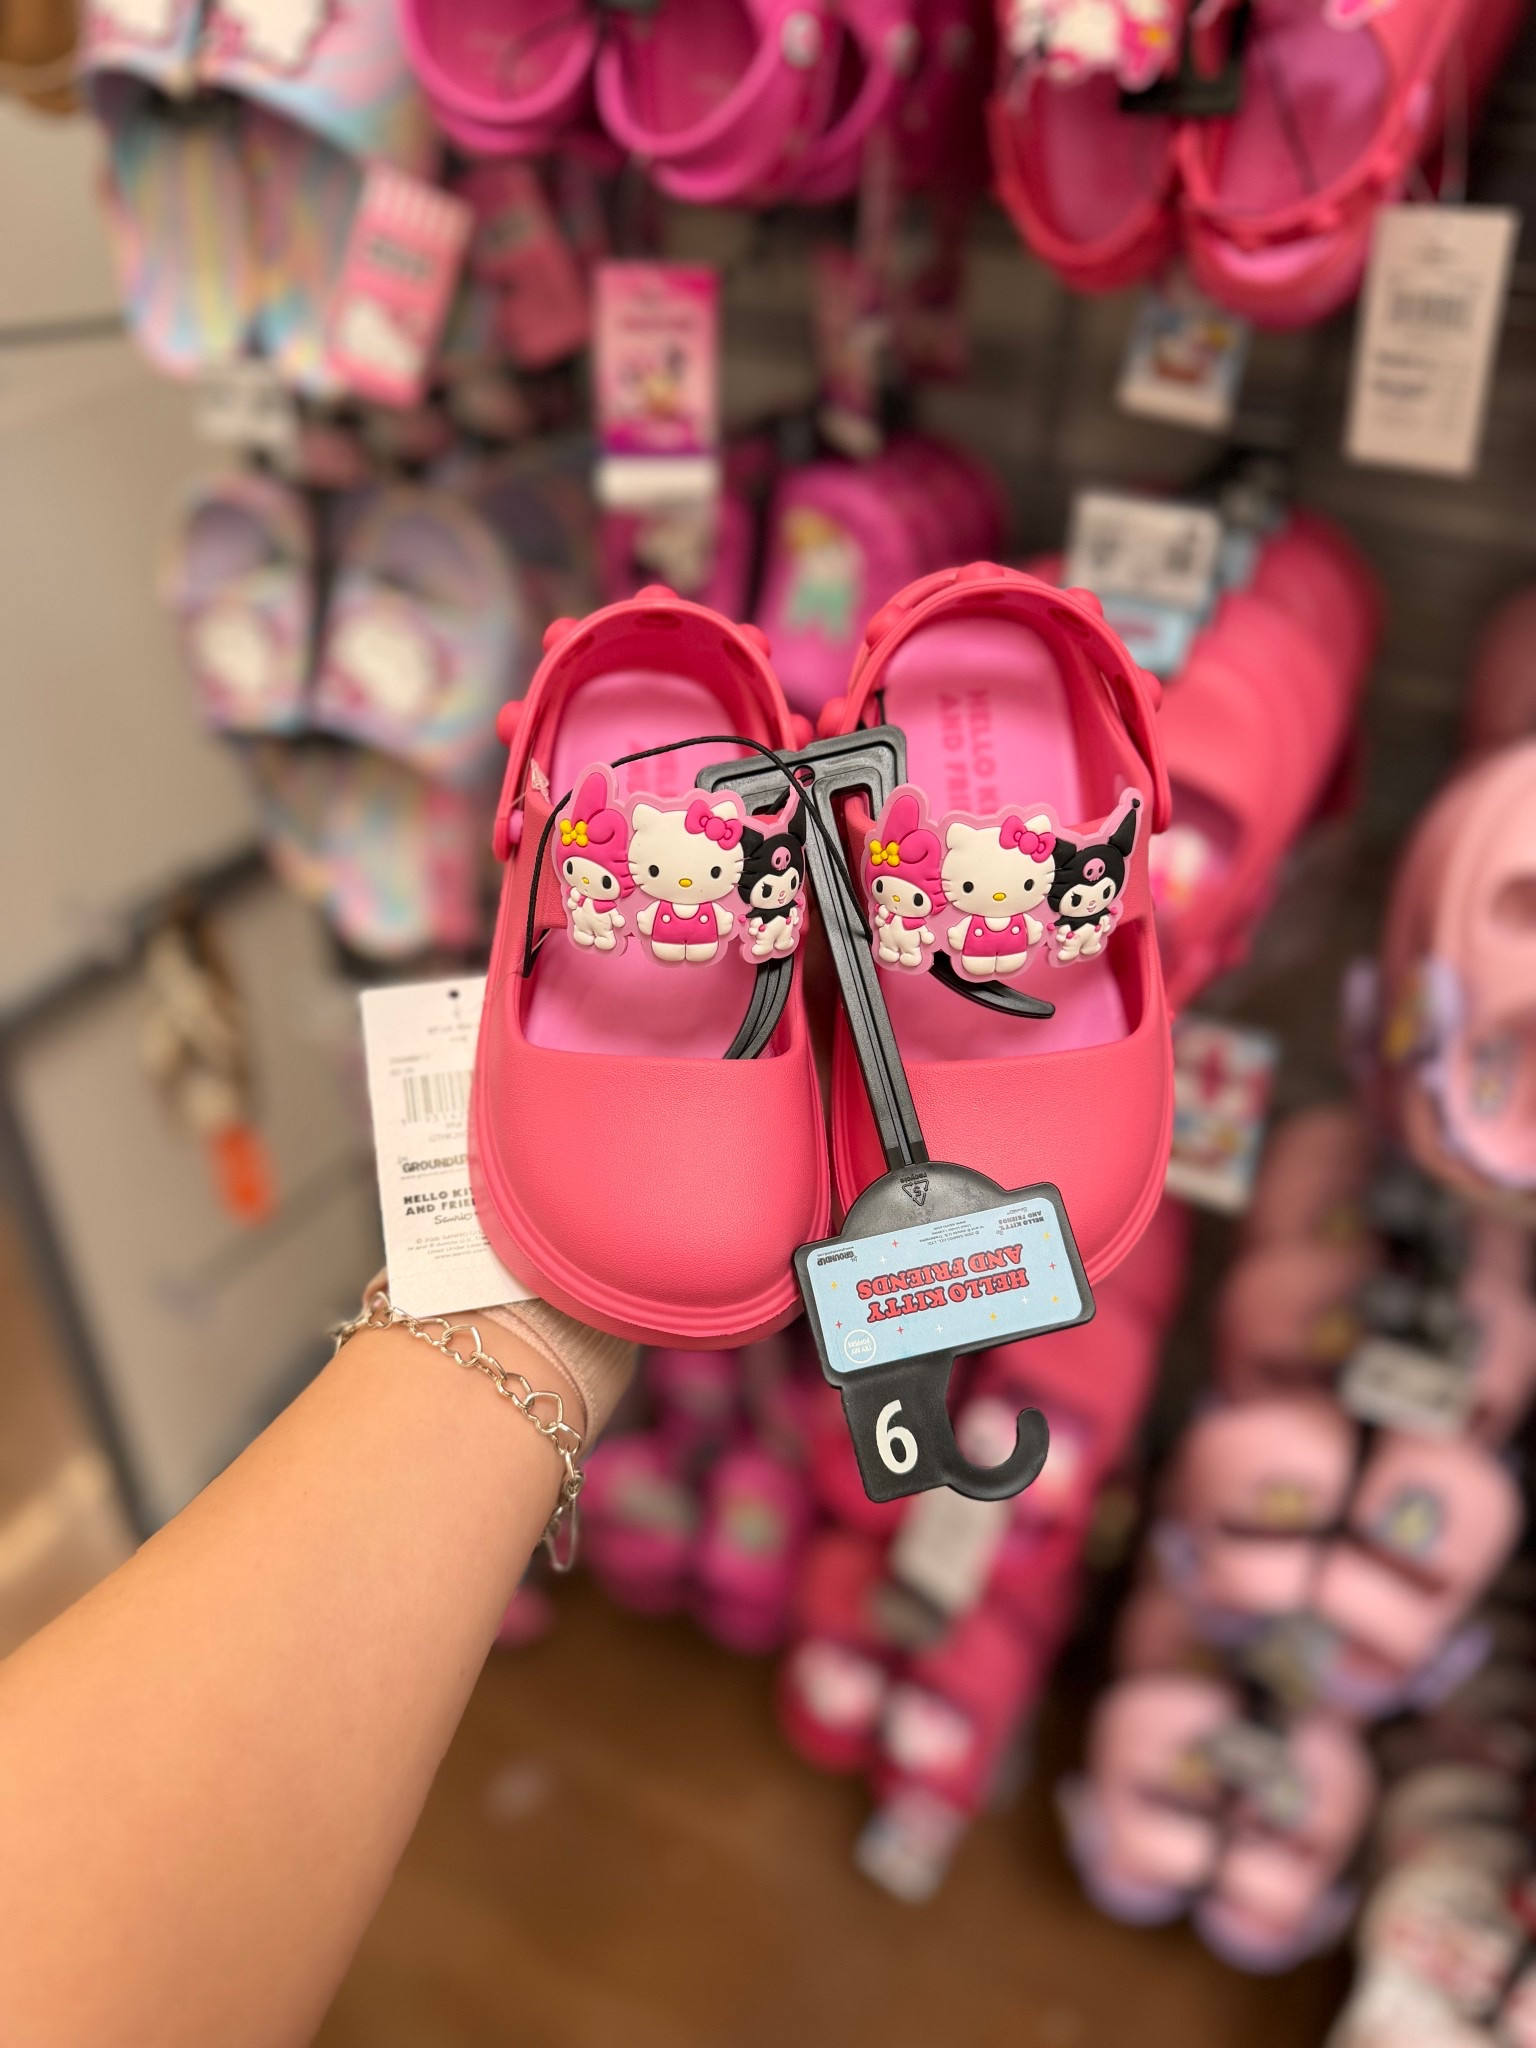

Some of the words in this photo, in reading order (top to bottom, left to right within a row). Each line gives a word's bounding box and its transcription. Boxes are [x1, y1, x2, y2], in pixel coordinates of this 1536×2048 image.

[938, 693, 964, 752] AND
[900, 1172, 928, 1184] recycle
[403, 1191, 448, 1205] HELLO
[912, 1185, 922, 1198] 5
[405, 1204, 436, 1216] AND
[1027, 1210, 1042, 1219] AND
[998, 1215, 1026, 1225] FRIENDS
[1000, 1221, 1022, 1231] KITTY
[1022, 1216, 1044, 1226] HELLO
[817, 1250, 854, 1266] GROUNDUP
[967, 1243, 1024, 1274] AND
[855, 1258, 967, 1300] FRIENDS
[947, 1268, 1030, 1303] HELLO
[866, 1287, 947, 1323] KITTY
